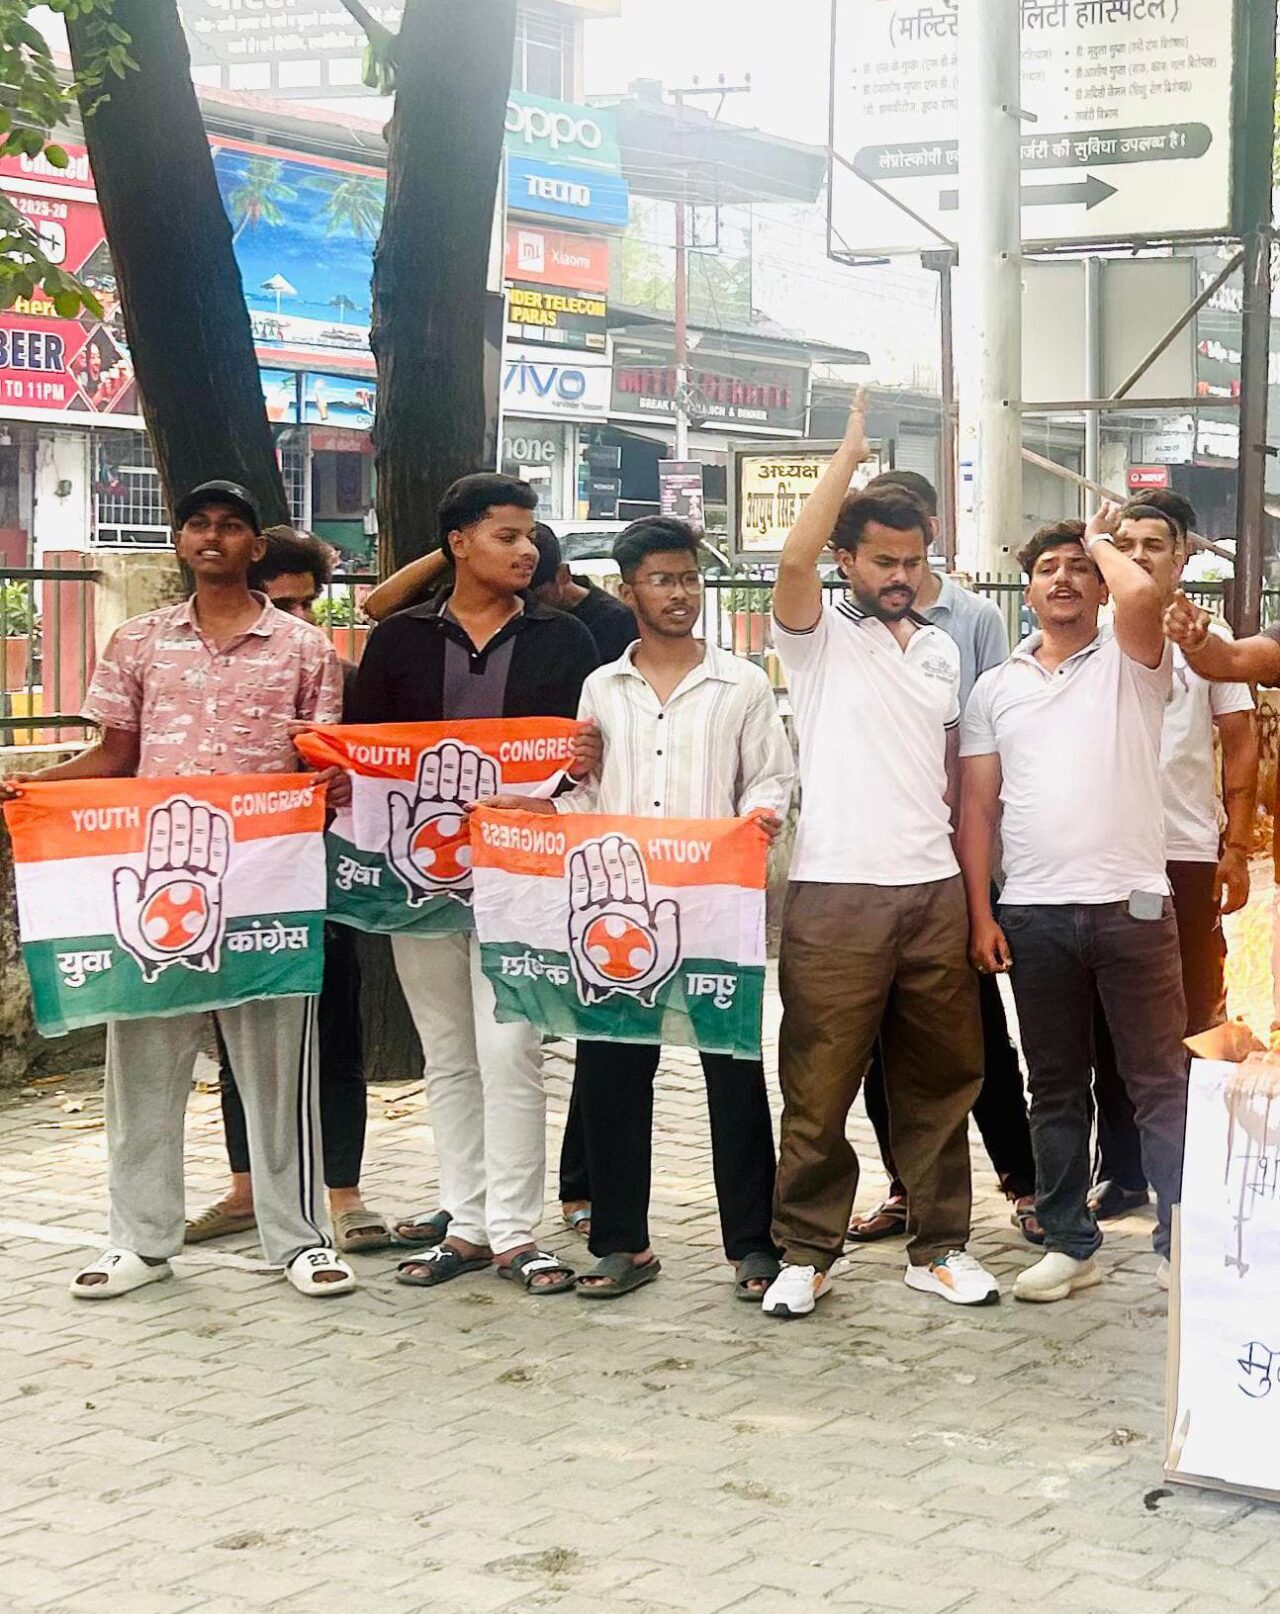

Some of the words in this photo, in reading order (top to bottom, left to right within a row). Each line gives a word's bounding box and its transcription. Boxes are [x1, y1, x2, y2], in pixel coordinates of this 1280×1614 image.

[551, 250, 591, 269] Xiaomi
[758, 465, 820, 479] अध्यक्ष
[345, 743, 411, 766] YOUTH
[500, 737, 578, 762] CONGRES
[71, 806, 140, 832] YOUTH
[335, 855, 384, 891] युवा
[56, 949, 113, 988] युवा
[226, 919, 310, 955] कांग्रेस
